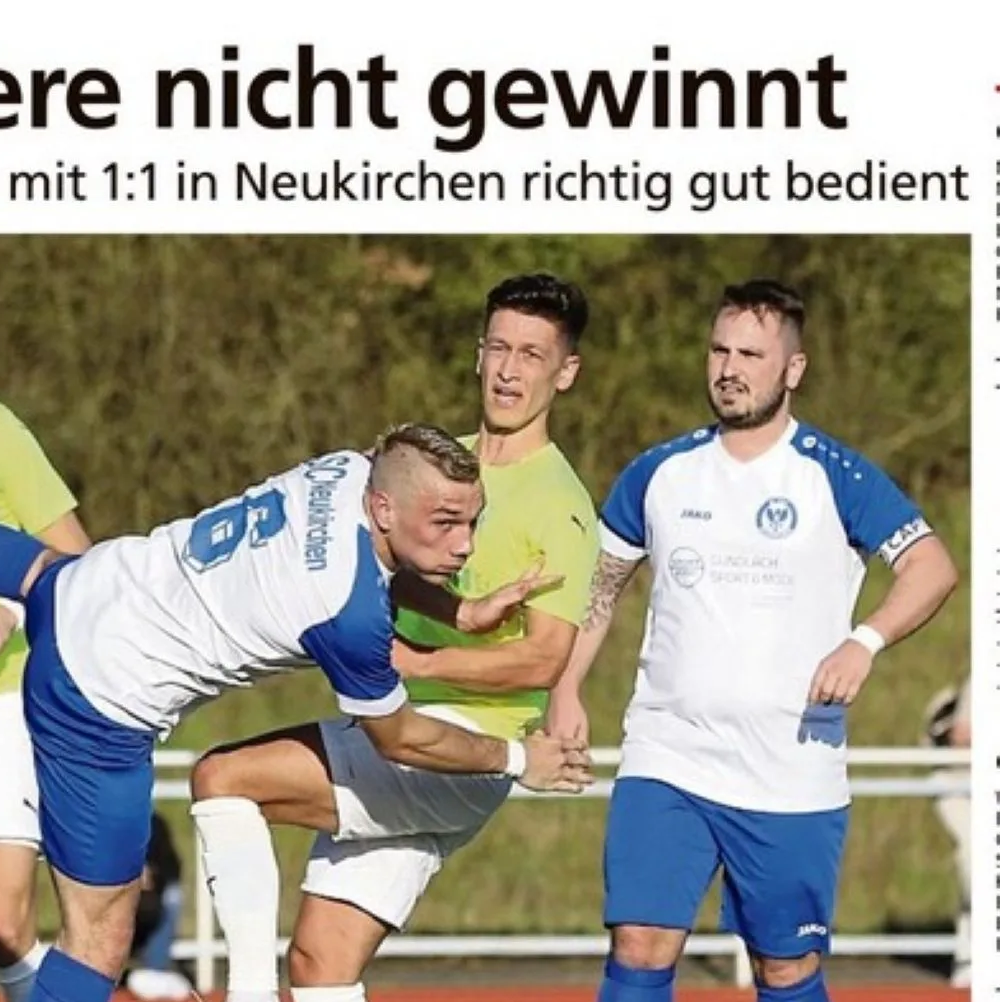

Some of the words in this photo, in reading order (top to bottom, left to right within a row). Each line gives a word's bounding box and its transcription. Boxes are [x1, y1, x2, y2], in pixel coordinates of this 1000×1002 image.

[155, 43, 399, 131] nicht
[427, 44, 849, 154] gewinnt
[9, 160, 87, 202] mit
[102, 161, 156, 201] 1:1
[177, 160, 218, 202] in
[236, 159, 506, 202] Neukirchen
[523, 159, 672, 212] richtig
[688, 164, 771, 212] gut
[786, 159, 970, 202] bedient
[182, 488, 287, 574] 6
